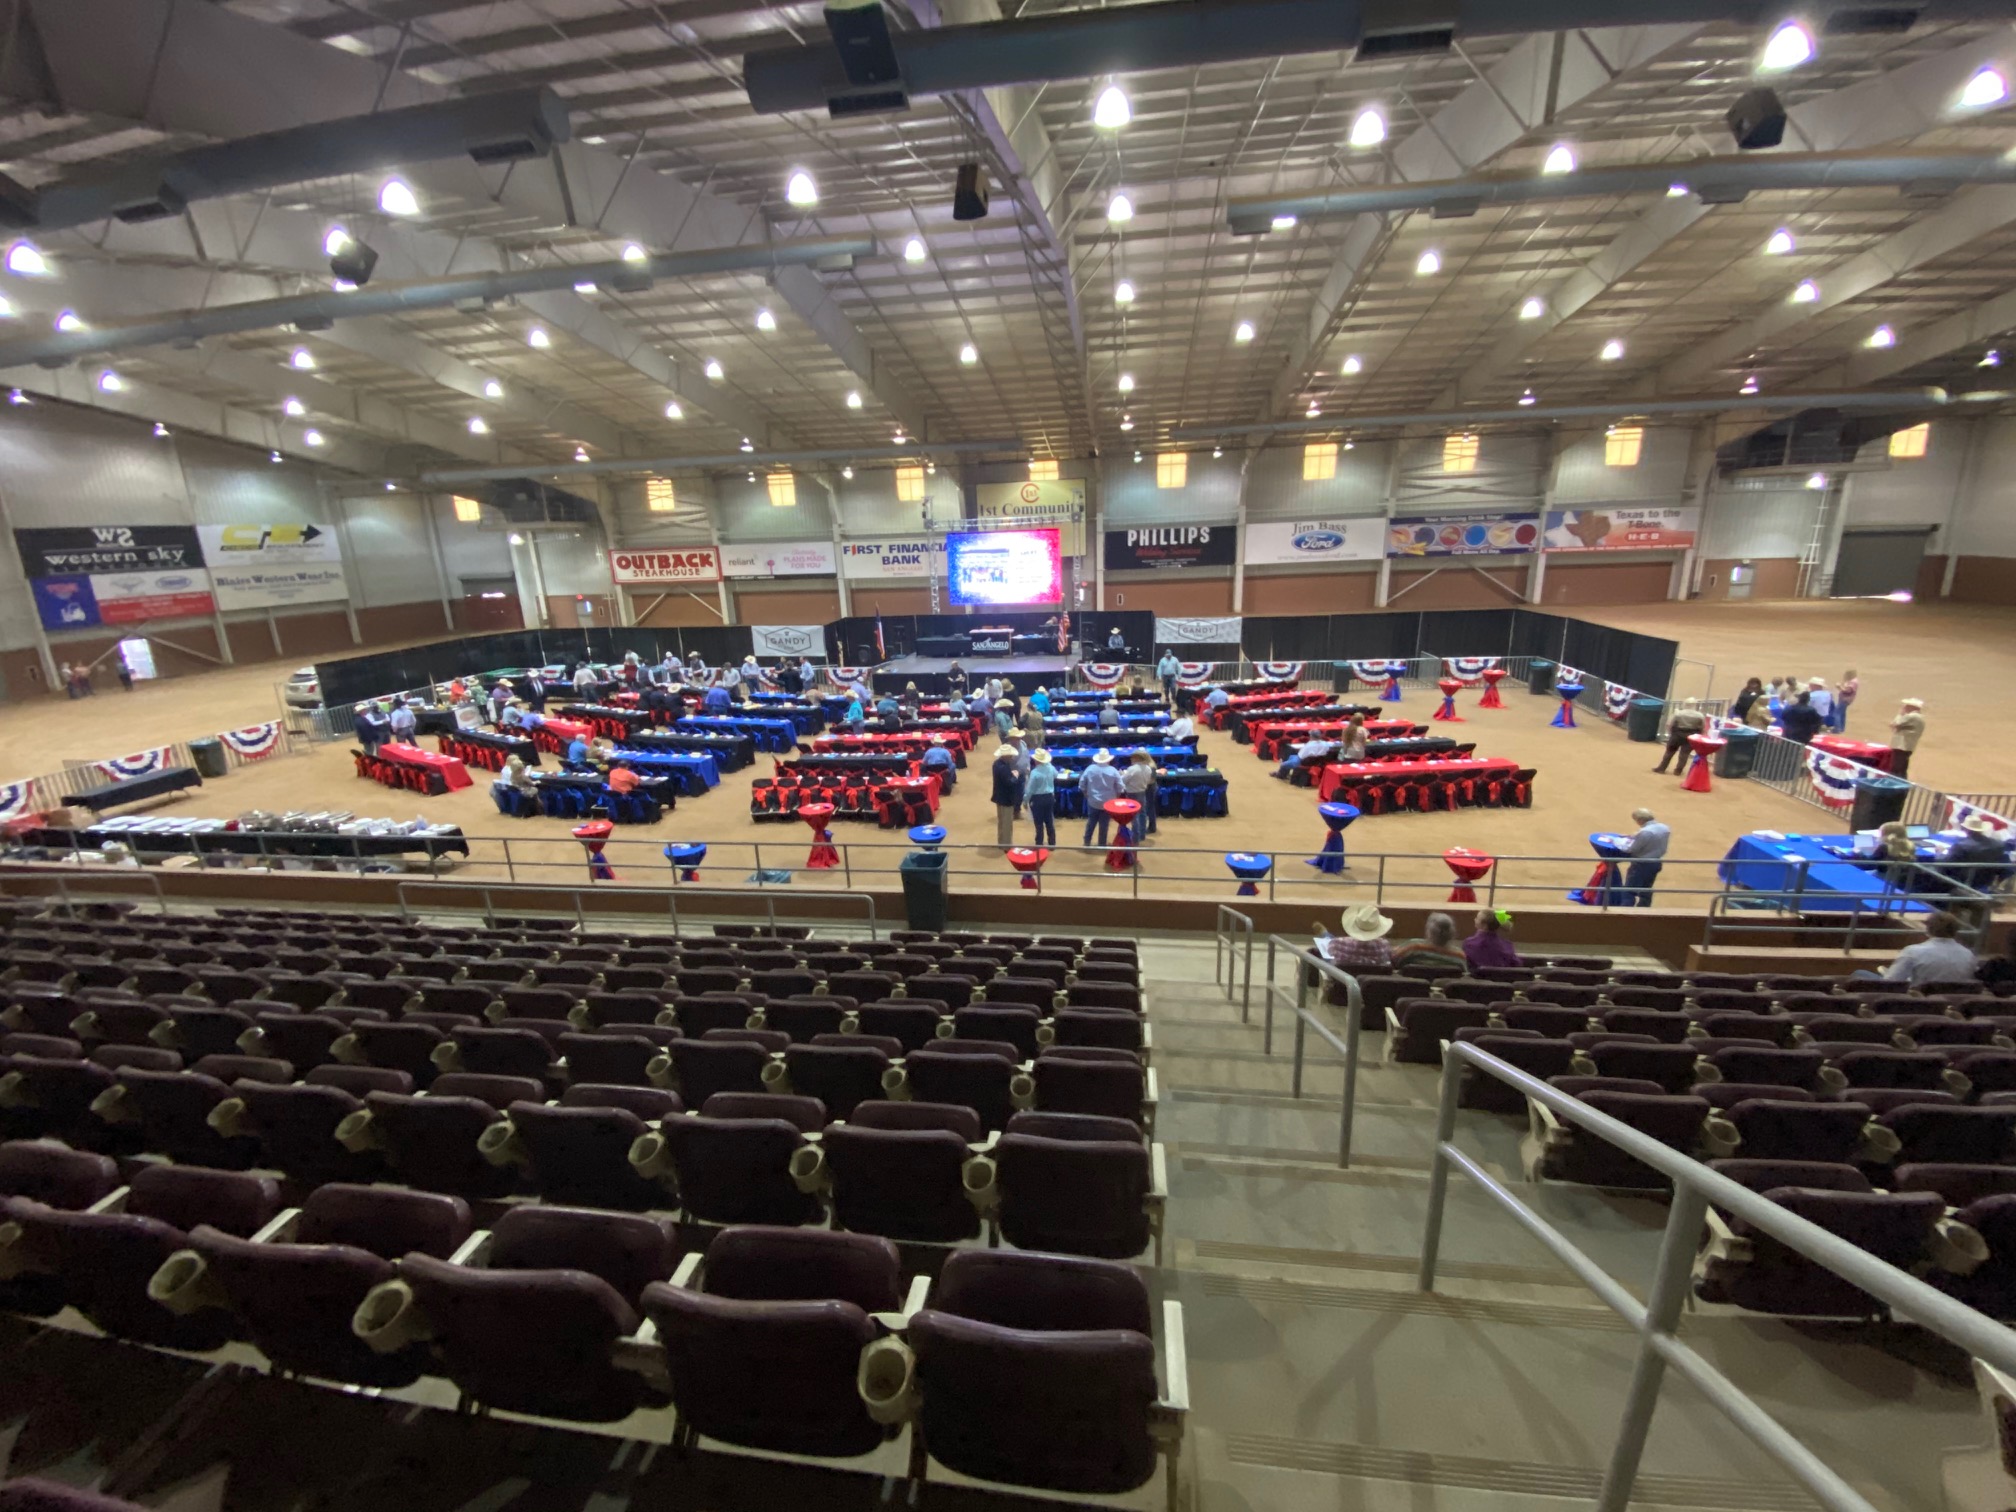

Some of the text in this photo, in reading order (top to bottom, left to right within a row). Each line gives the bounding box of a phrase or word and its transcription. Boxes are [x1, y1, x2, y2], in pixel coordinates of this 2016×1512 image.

[980, 504, 997, 516] 1st
[1616, 511, 1644, 519] Texas
[1662, 510, 1681, 518] the
[1291, 521, 1347, 536] Jim Bass
[1127, 526, 1210, 547] PHILLIPS
[1301, 535, 1335, 549] Ford
[843, 544, 882, 556] FIRST
[45, 547, 184, 566] western sky
[616, 553, 714, 570] OUTBACK
[728, 557, 756, 566] reliant
[882, 555, 921, 565] BANK
[251, 574, 296, 584] Western
[296, 572, 323, 582] Wear
[633, 568, 700, 577] STEAKHOUSE
[770, 637, 805, 645] GANDY
[972, 640, 1009, 650] SAN ANGELO
